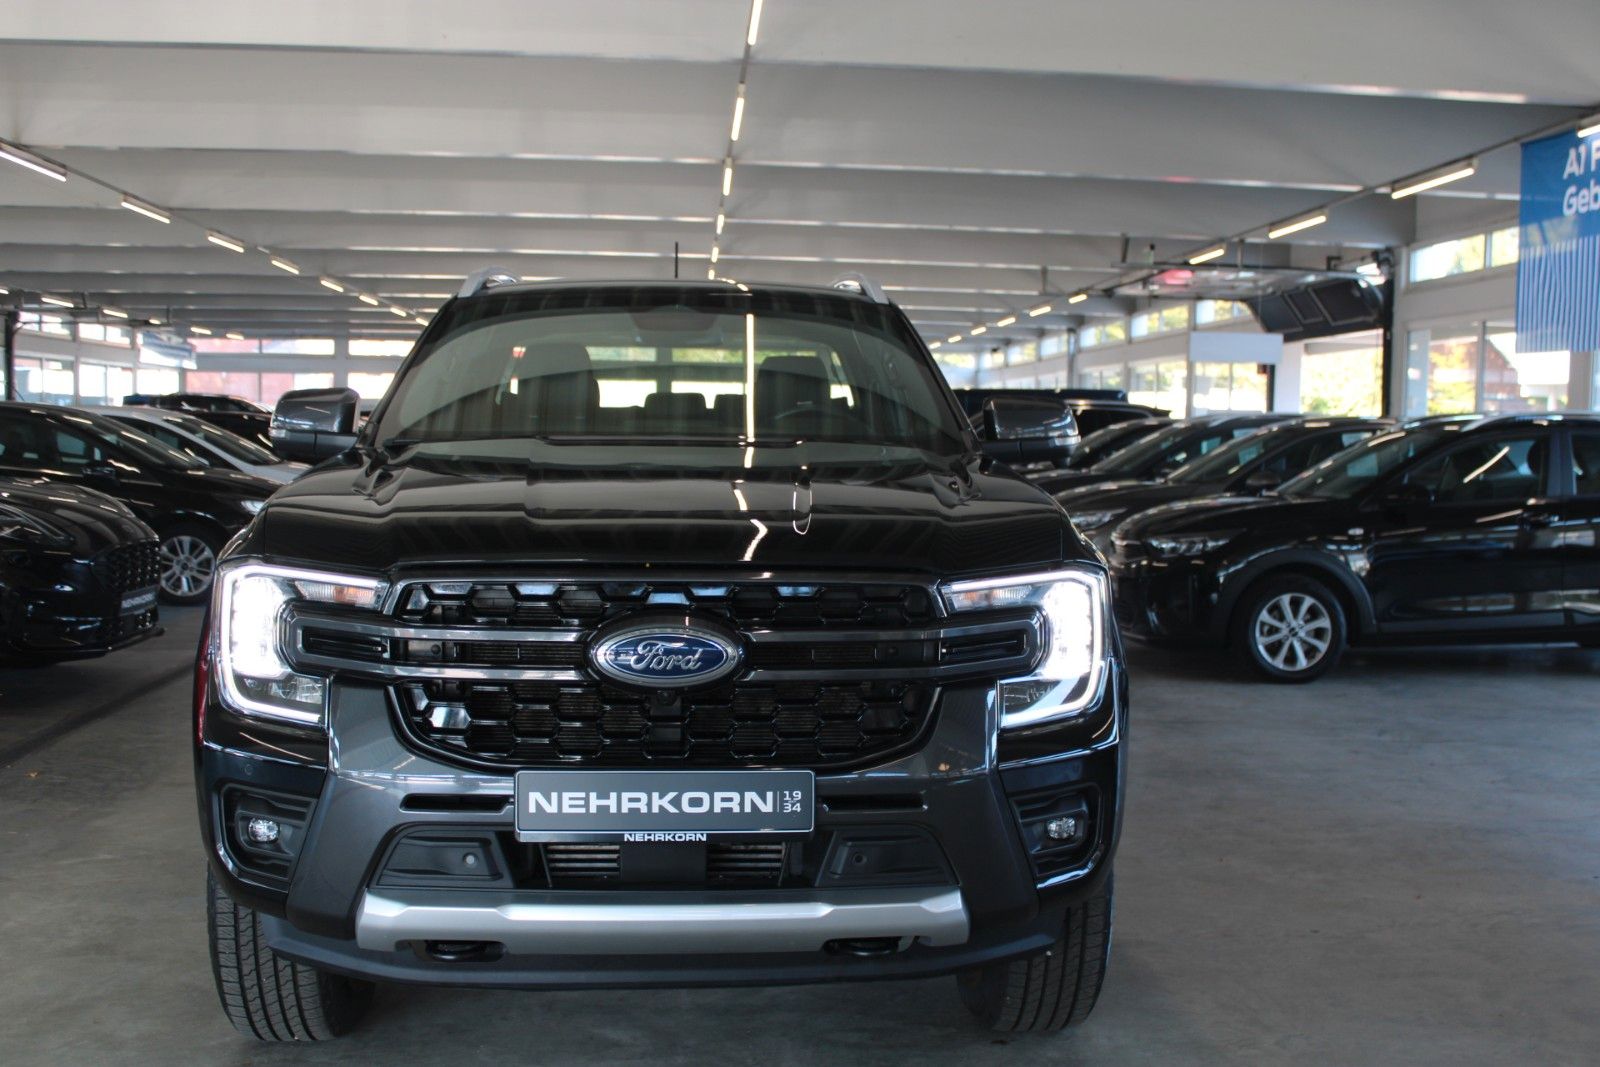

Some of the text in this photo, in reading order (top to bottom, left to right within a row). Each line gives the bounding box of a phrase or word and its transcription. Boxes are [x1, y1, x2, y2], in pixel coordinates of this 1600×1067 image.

[1563, 143, 1587, 180] A1
[630, 640, 703, 670] Ford
[528, 791, 773, 813] NEHRKORN
[783, 790, 802, 801] 19
[783, 802, 802, 813] 34
[624, 832, 707, 842] NEHRKORN
